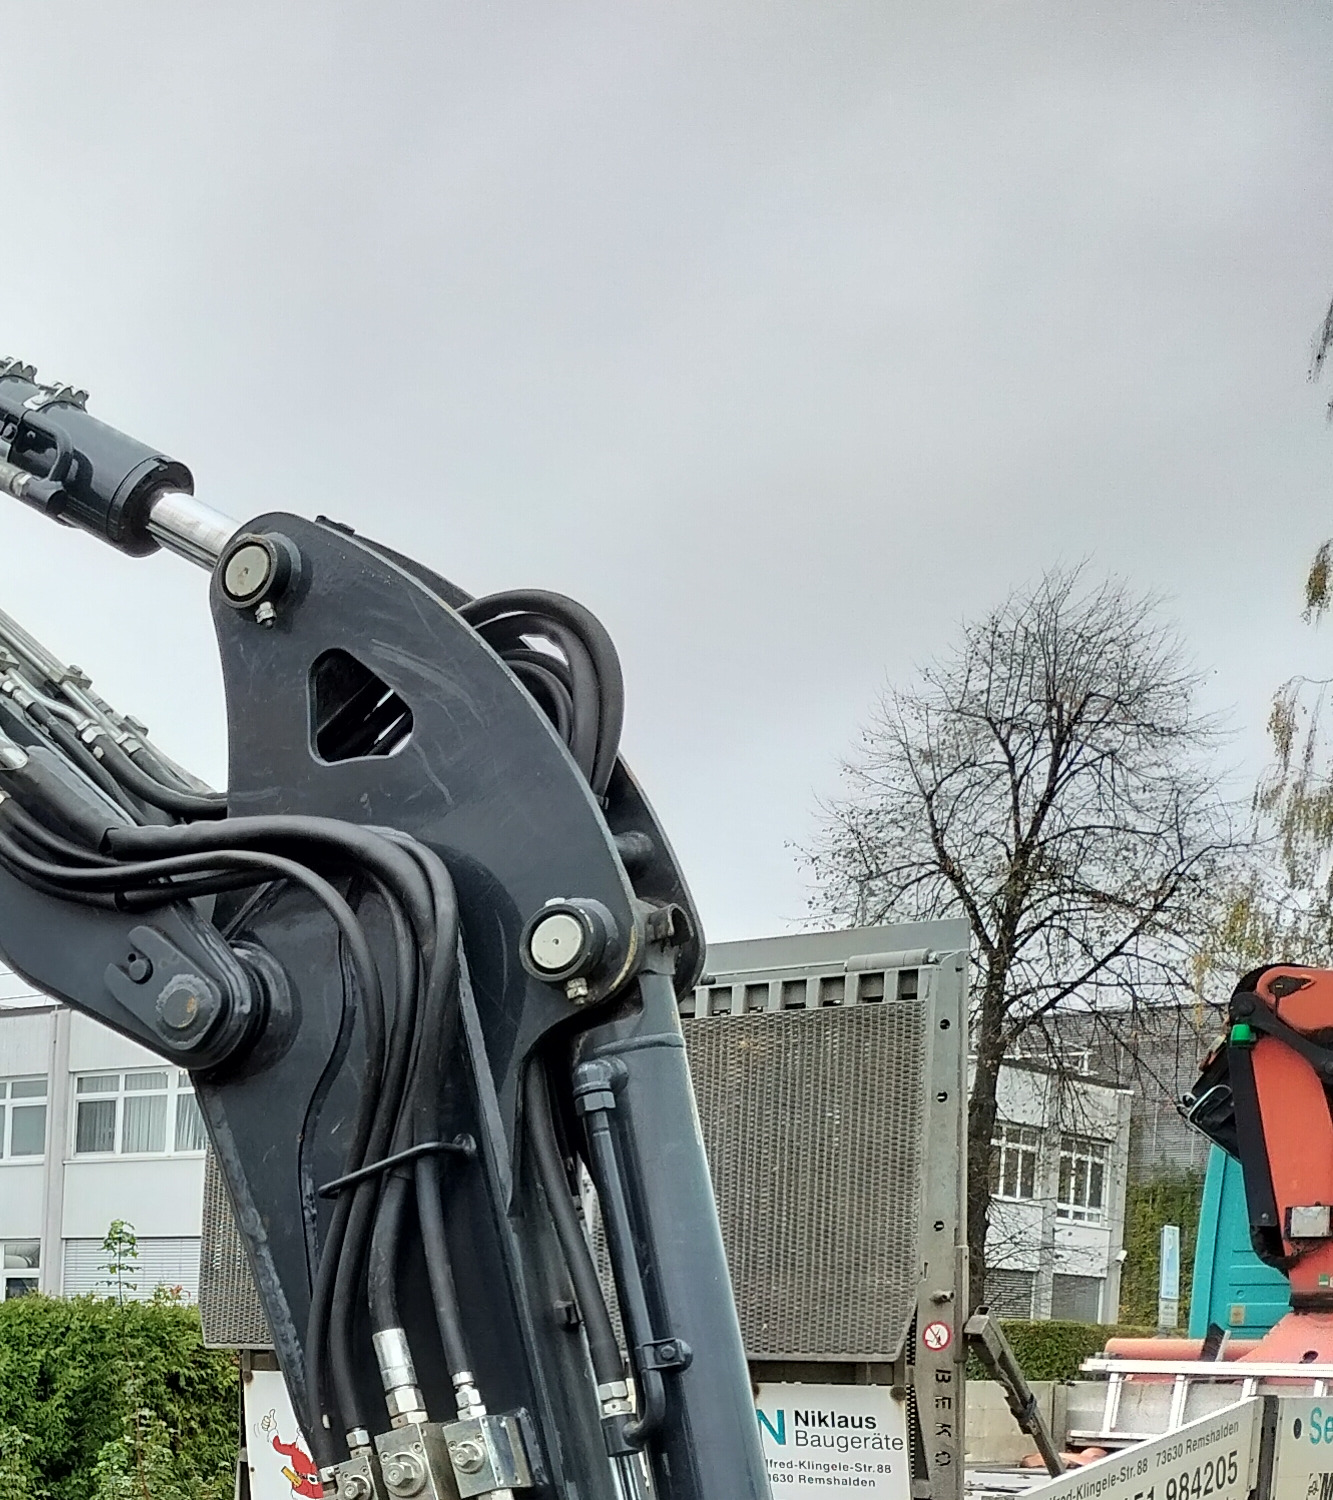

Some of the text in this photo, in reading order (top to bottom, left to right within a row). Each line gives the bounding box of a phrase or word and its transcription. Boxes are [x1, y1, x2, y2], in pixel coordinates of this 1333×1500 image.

[794, 1410, 877, 1430] Niklaus
[795, 1430, 904, 1453] Baugeräte
[1155, 1441, 1183, 1468] 73630
[1185, 1420, 1239, 1455] Remshalden
[798, 1475, 876, 1488] Remshalden
